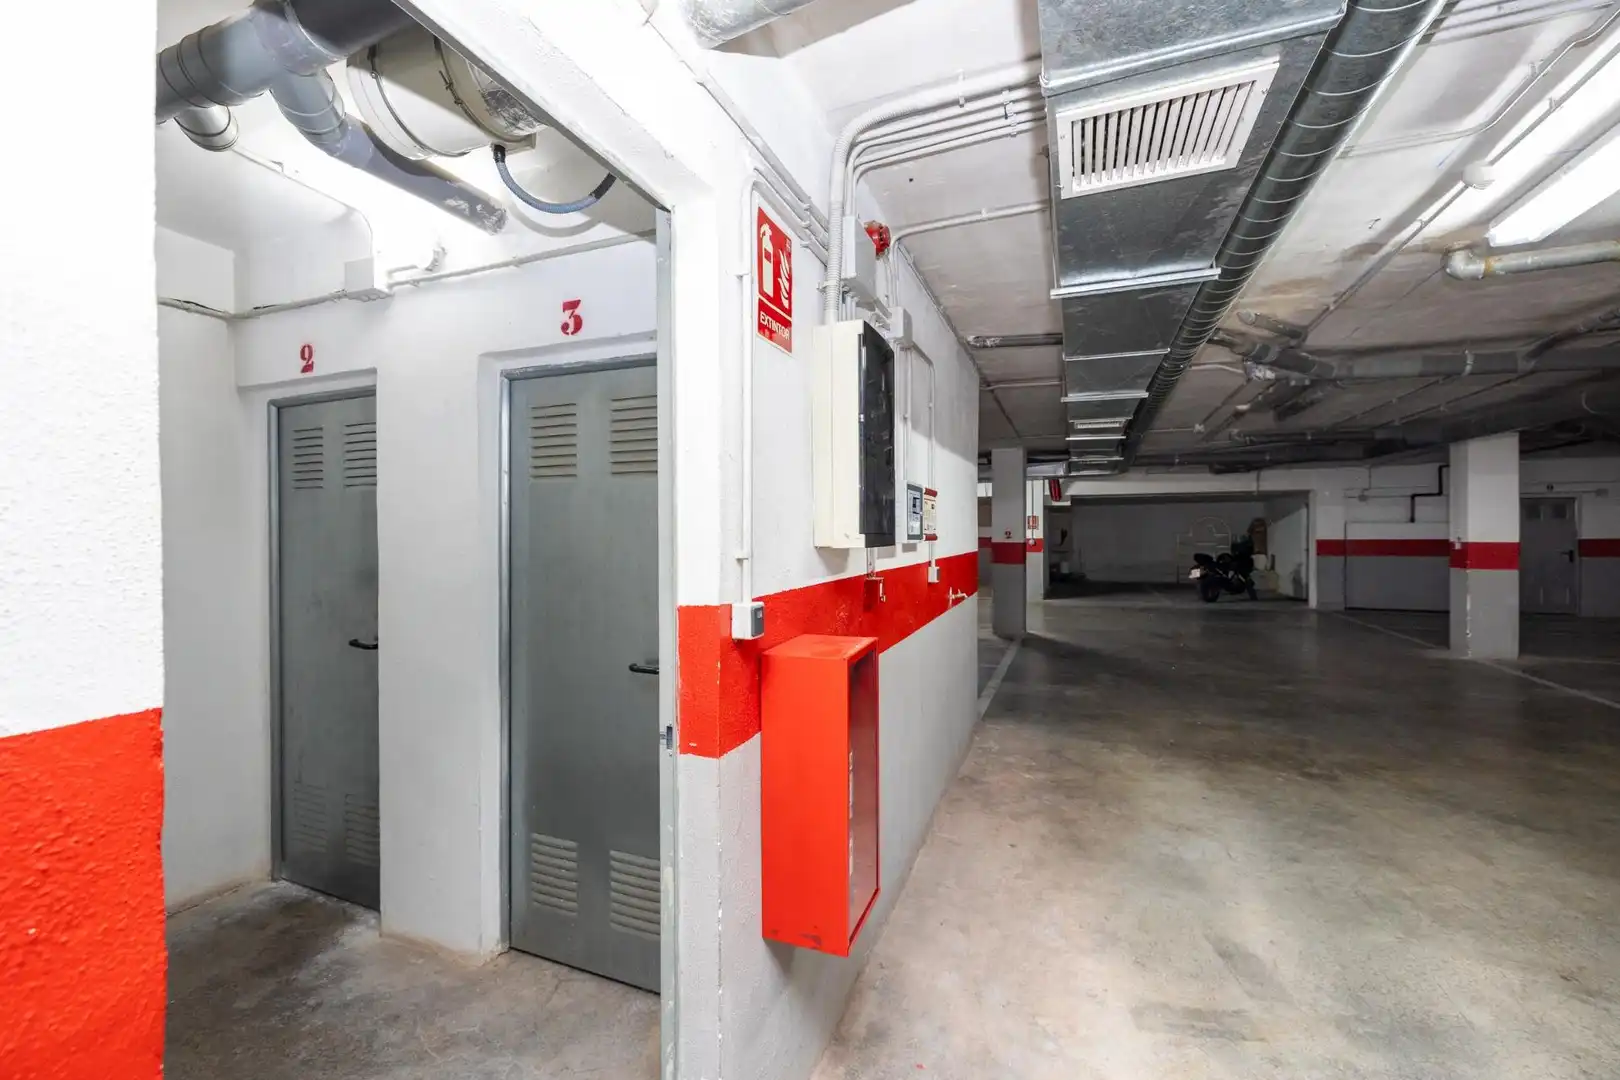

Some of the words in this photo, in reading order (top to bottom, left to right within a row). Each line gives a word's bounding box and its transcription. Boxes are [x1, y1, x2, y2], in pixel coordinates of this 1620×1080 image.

[560, 299, 583, 335] 3
[760, 310, 790, 340] EXTINTOR
[300, 343, 314, 373] 2
